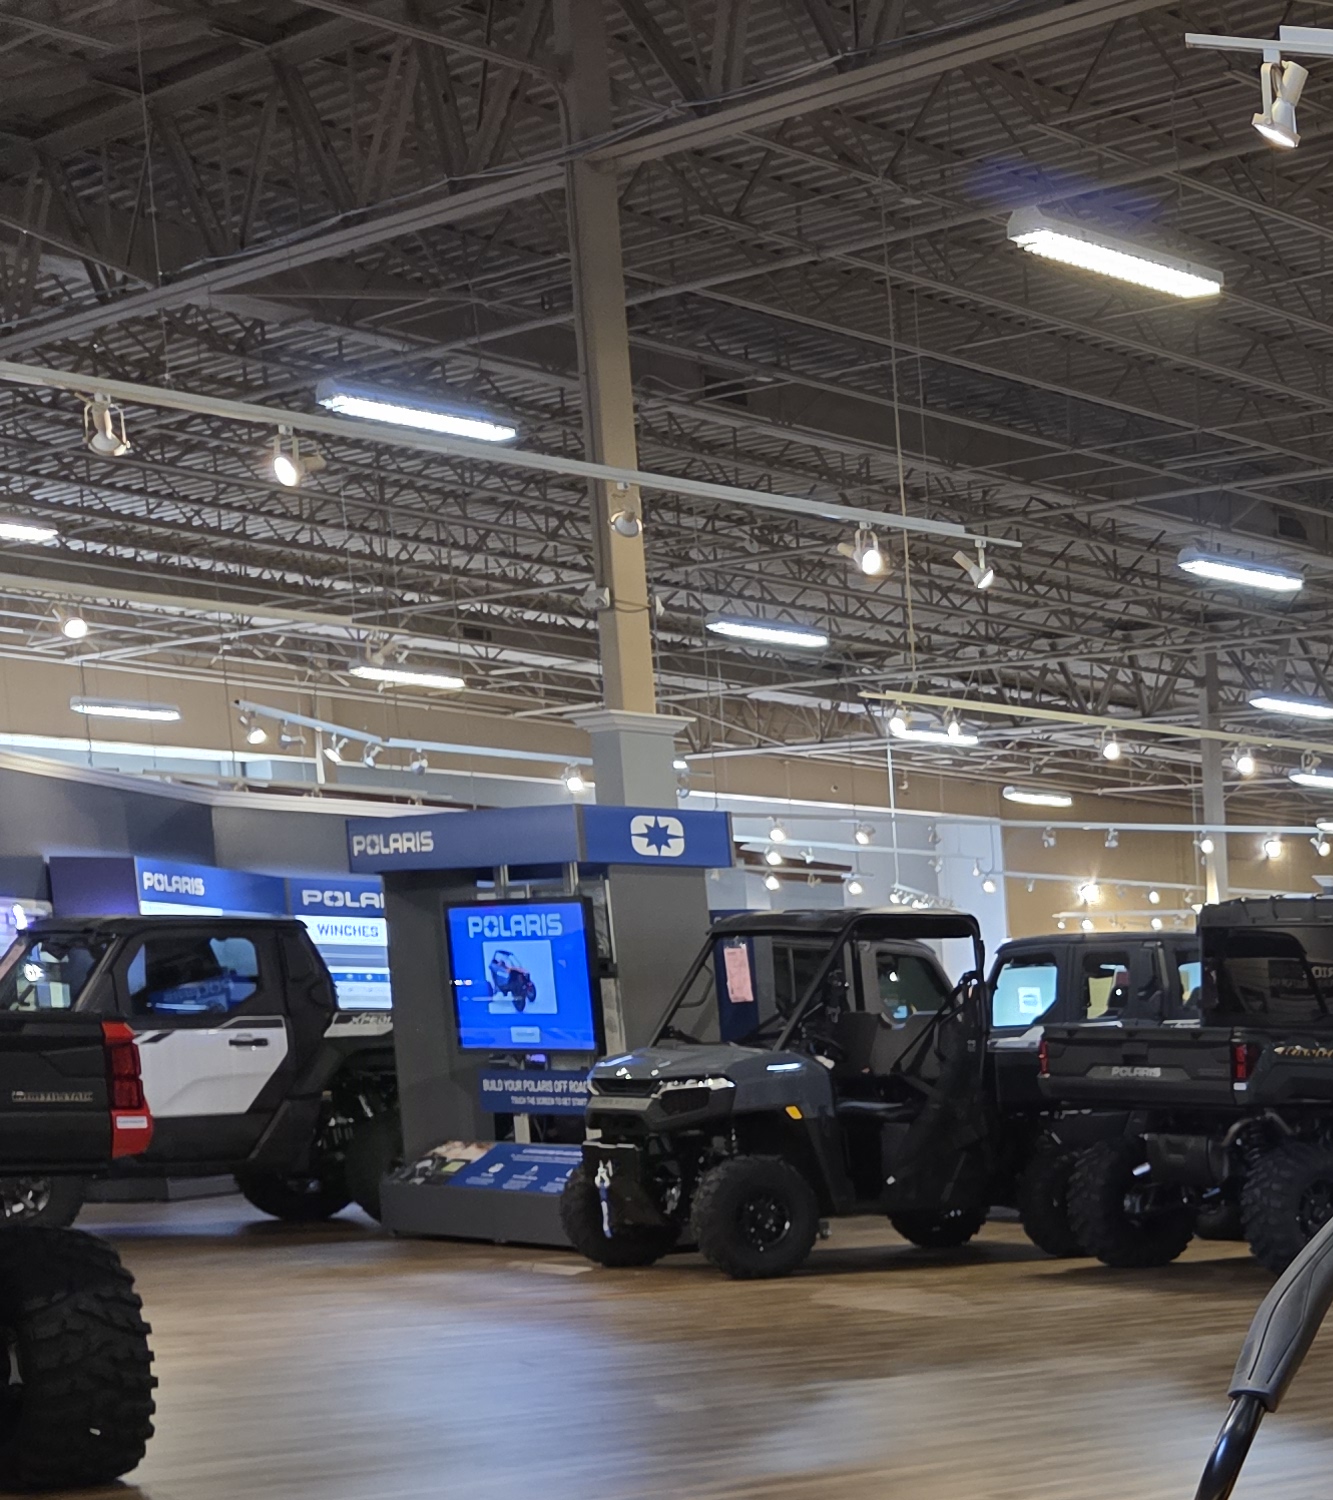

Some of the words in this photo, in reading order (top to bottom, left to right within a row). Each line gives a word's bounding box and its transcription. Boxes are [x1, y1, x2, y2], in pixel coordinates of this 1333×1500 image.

[352, 831, 434, 857] POLARIS
[142, 871, 205, 896] POLARIS
[317, 923, 379, 938] WINCHES
[467, 913, 563, 938] POLARIS
[1111, 1066, 1161, 1078] POLARIS
[504, 1079, 523, 1092] YOUR
[524, 1079, 553, 1093] POLARIS
[554, 1080, 568, 1093] OFF
